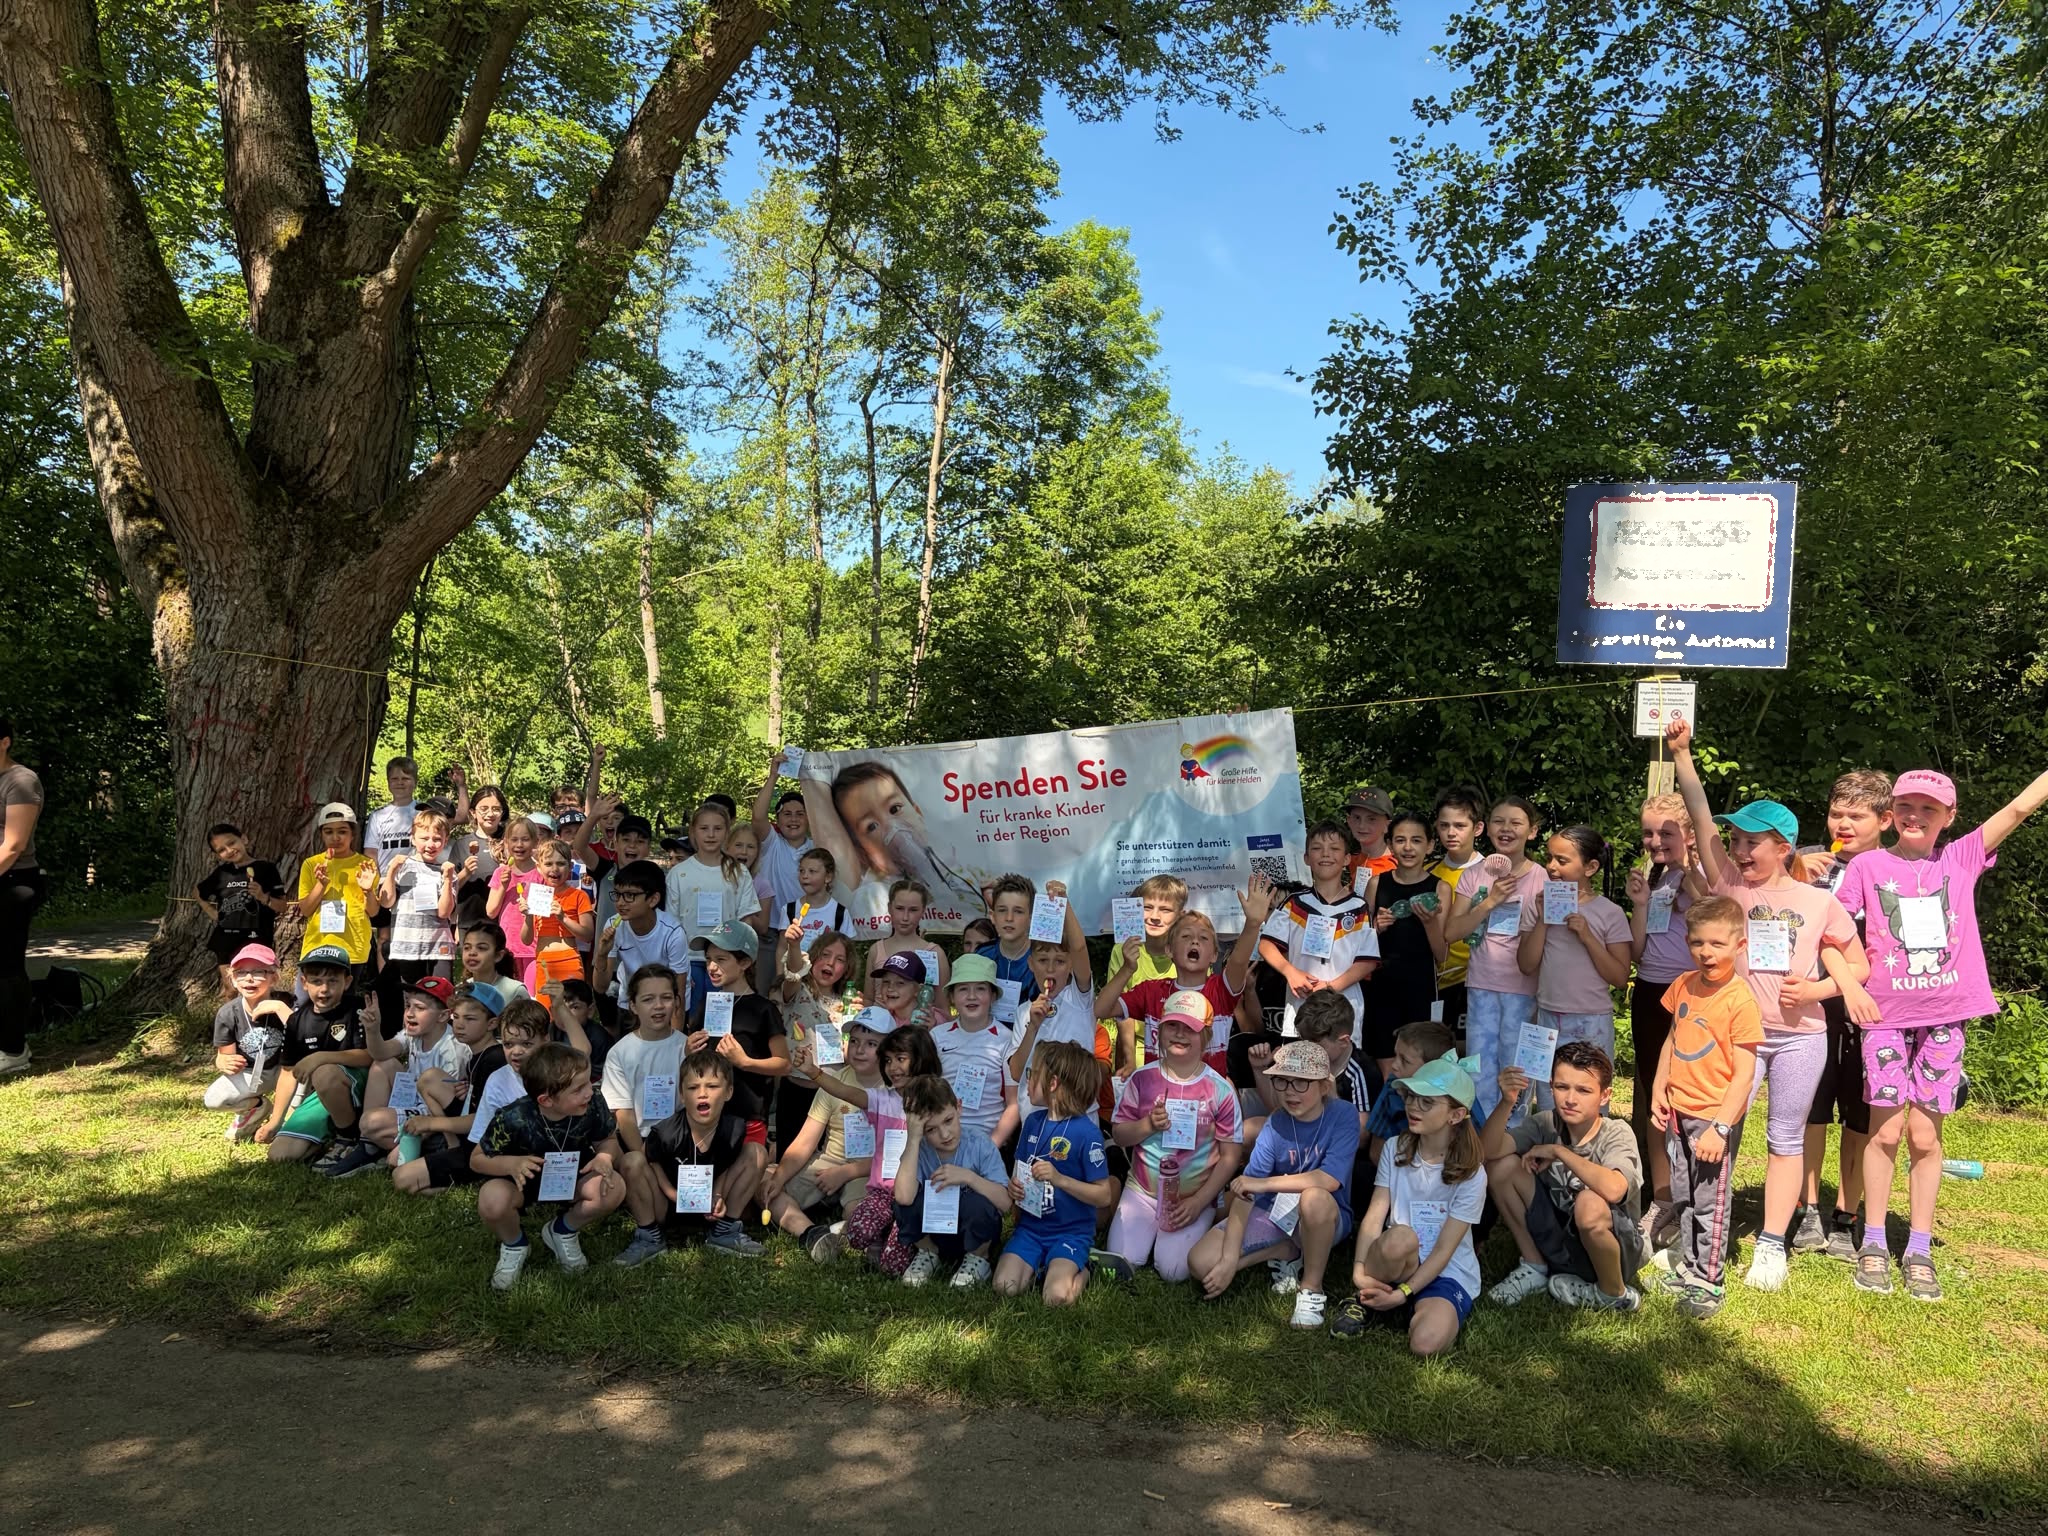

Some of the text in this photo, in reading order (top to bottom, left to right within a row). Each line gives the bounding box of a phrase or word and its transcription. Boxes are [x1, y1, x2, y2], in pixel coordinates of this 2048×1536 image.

[1221, 767, 1257, 776] Große Hilfe
[943, 759, 1127, 813] Spenden Sie
[1206, 775, 1261, 786] für kleine Helden
[979, 800, 1106, 824] für kranke Kinder
[976, 824, 1070, 843] in der Region
[1116, 838, 1231, 851] Sie unterstützen damit:
[1121, 855, 1219, 866] ganzheitliche Therapiekonzepte
[1132, 866, 1192, 875] kinderfreundliches
[1193, 864, 1236, 872] Klinikumfeld
[1197, 883, 1236, 891] Versorgung
[1891, 970, 1959, 991] KUROMI
